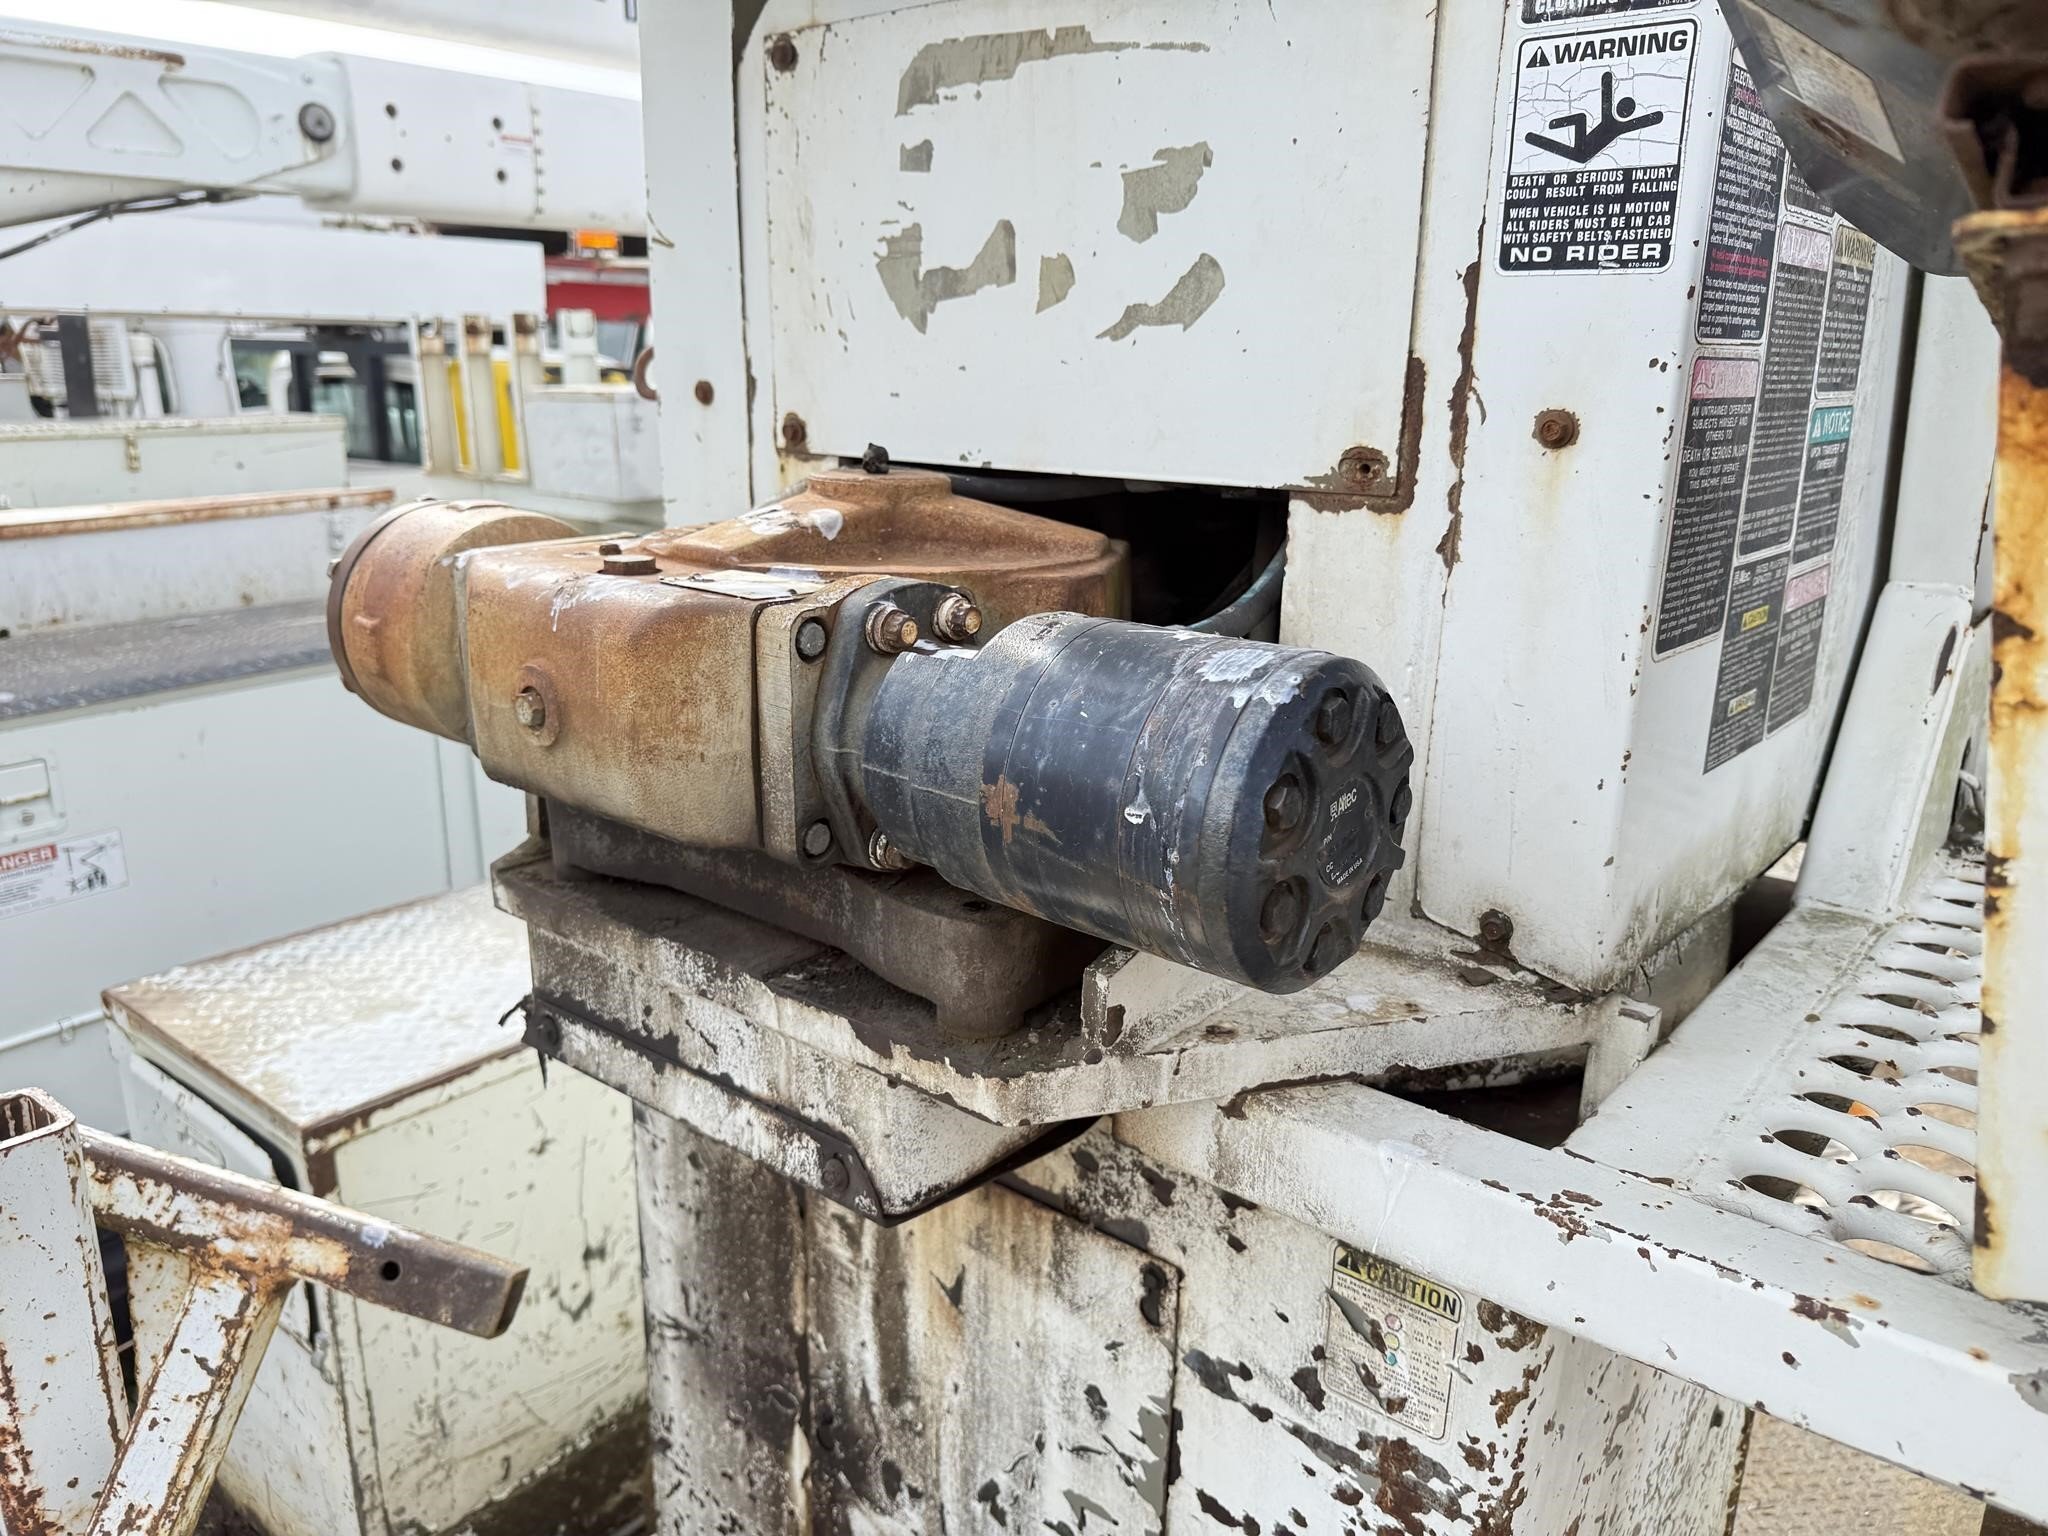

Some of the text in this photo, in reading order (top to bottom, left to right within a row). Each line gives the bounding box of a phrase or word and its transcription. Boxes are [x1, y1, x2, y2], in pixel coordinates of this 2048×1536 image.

[1554, 30, 1688, 64] WARNING
[1512, 167, 1674, 187] DEATH OR SERIOUS INJURY
[1506, 180, 1678, 200] COULD RESULT FROM FALLING
[1510, 201, 1669, 218] WHEN VEHICLE IS IN MOTION
[1506, 214, 1672, 232] ALL RIDERS MUST BE IN CAB
[1503, 228, 1672, 244] WITH SAFETY BELTS FASTENED
[1510, 244, 1662, 263] NO RIDER
[1691, 404, 1752, 416] AN UNTRAINED OPERATOR
[1692, 418, 1718, 429] SUBJECTS
[1823, 412, 1852, 435] NOTICE
[1705, 429, 1732, 441] OTHERS TO
[1681, 449, 1701, 463] DEATH
[1702, 448, 1710, 461] OR
[1711, 445, 1732, 459] SERIOUS
[1338, 788, 1357, 816] Altec
[1337, 870, 1348, 885] MADE
[1349, 866, 1354, 874] IN
[1354, 858, 1363, 870] USA
[1366, 1261, 1457, 1317] CAUTION
